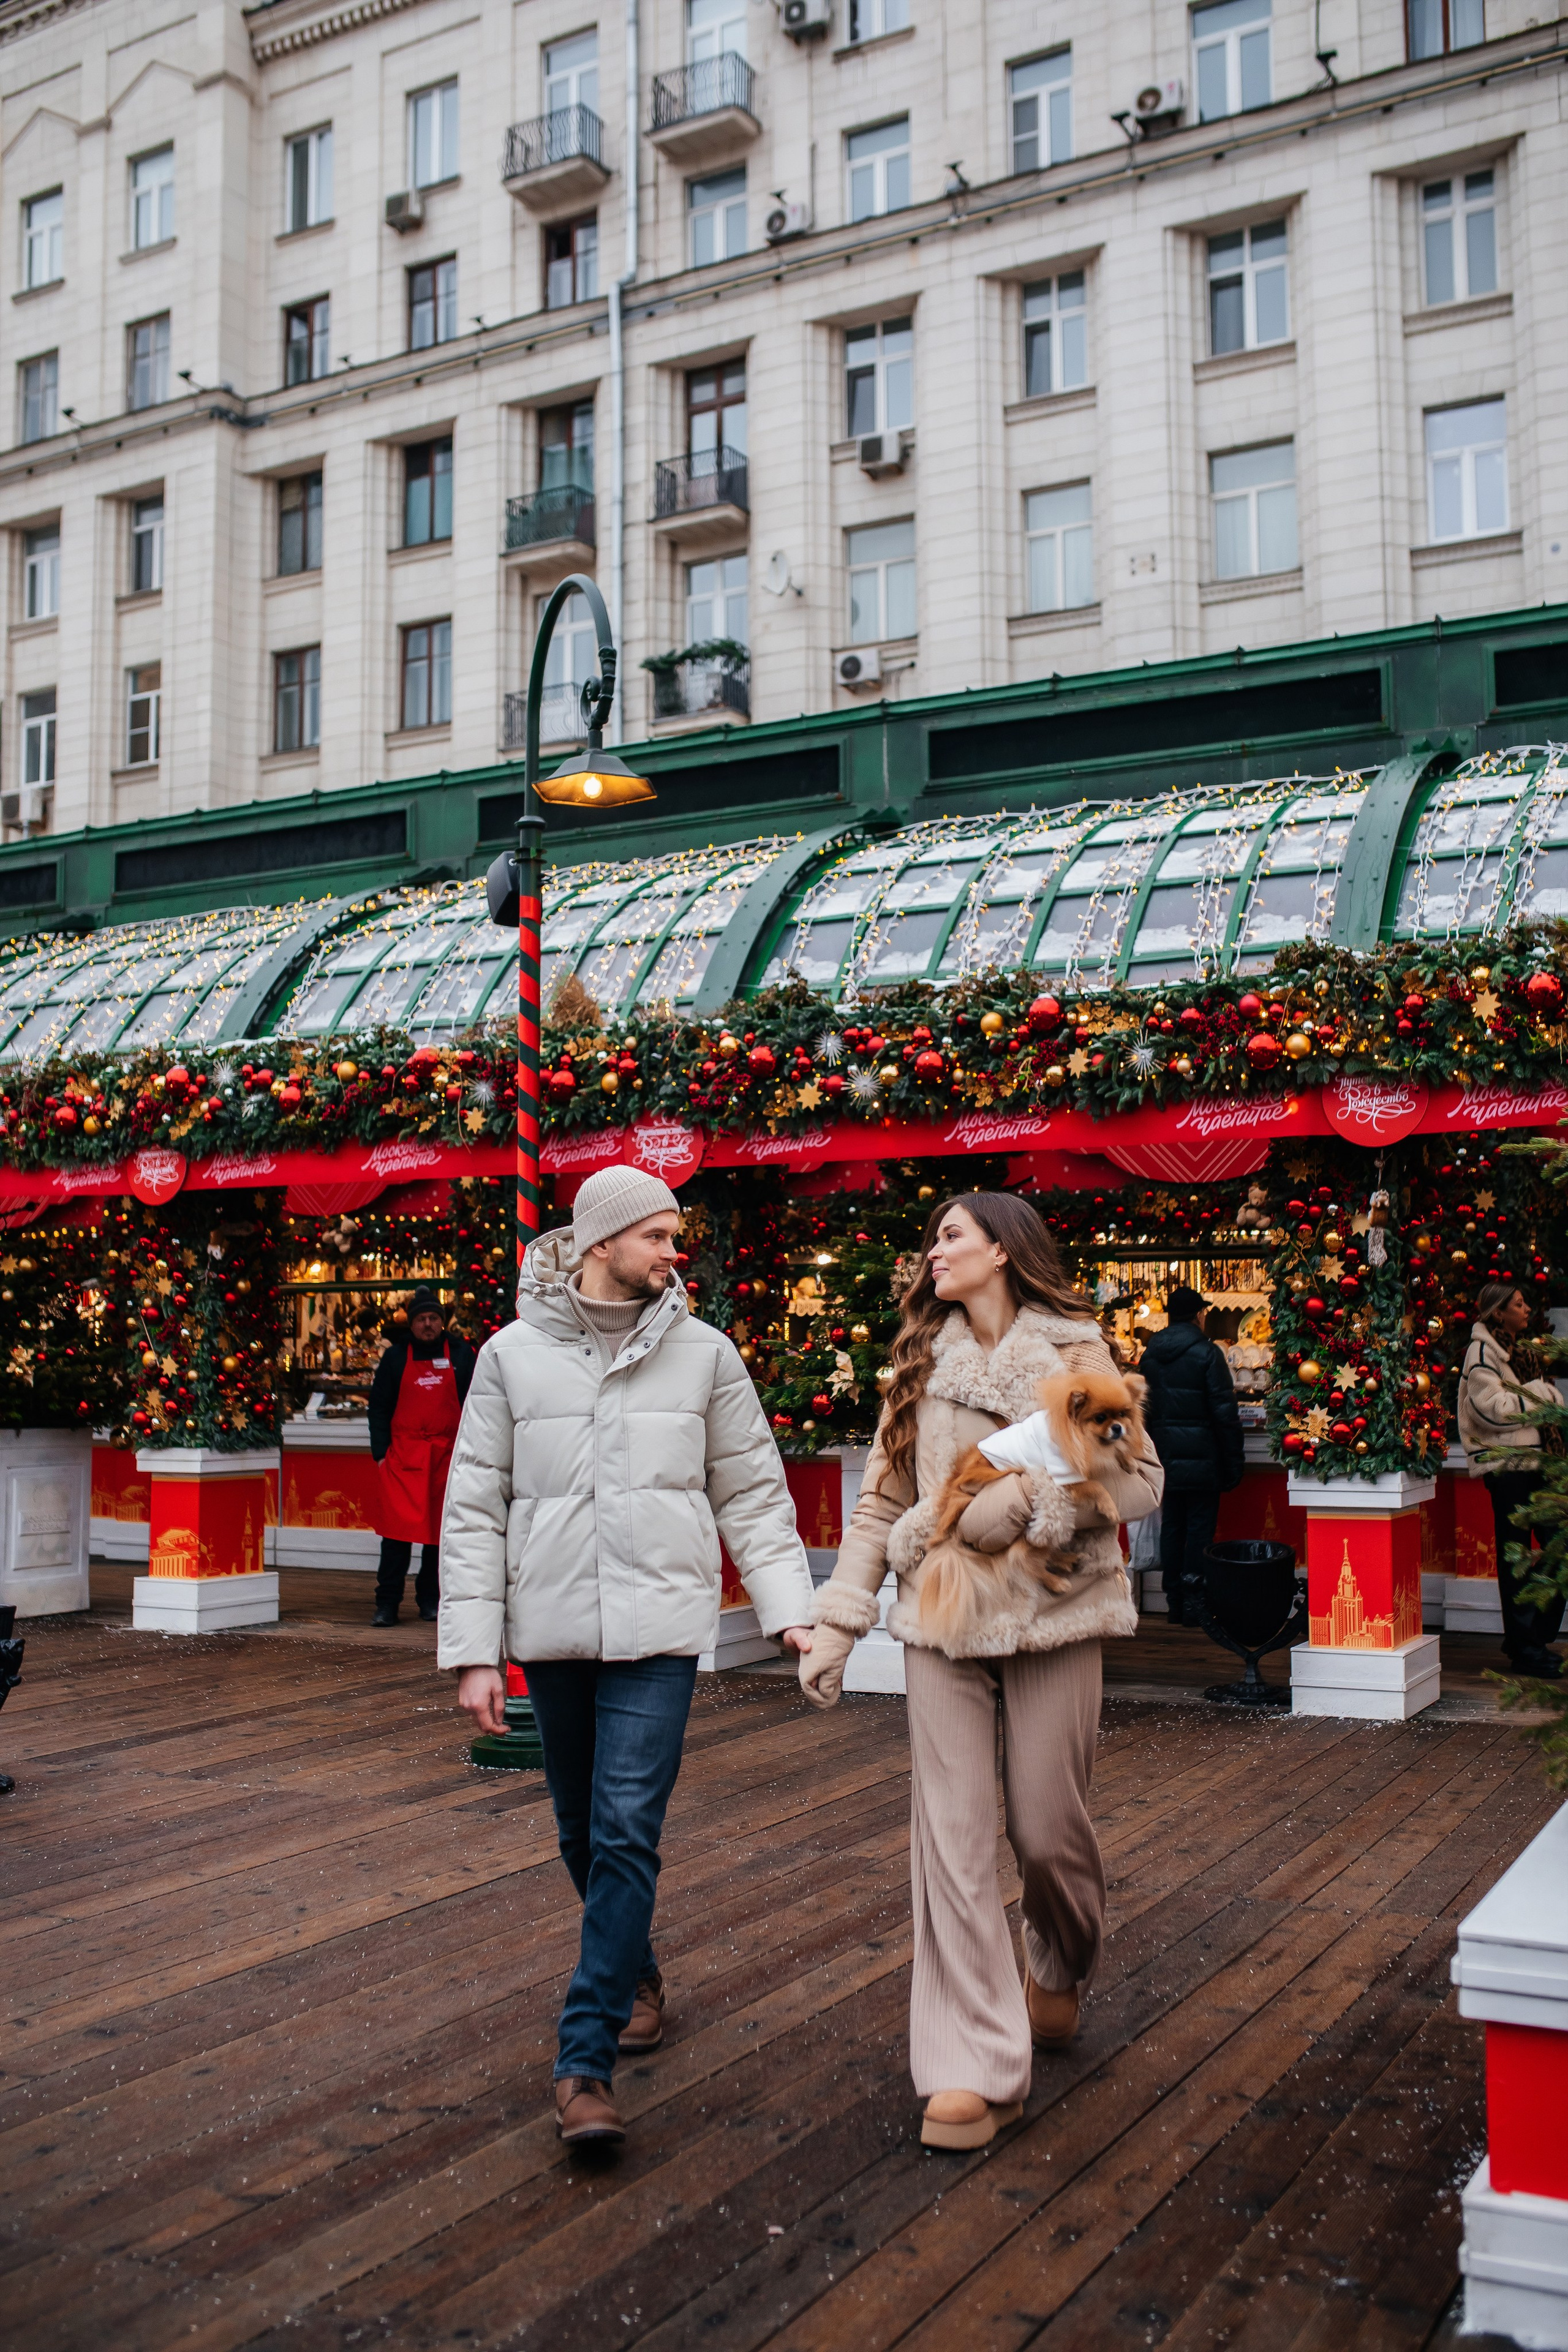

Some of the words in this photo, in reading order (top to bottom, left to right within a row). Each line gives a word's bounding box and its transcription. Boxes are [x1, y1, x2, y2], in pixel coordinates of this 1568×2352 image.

[957, 1116, 1051, 1149] чаепитие
[1189, 1101, 1292, 1137] чаепитие
[546, 1140, 622, 1169] чаепитие
